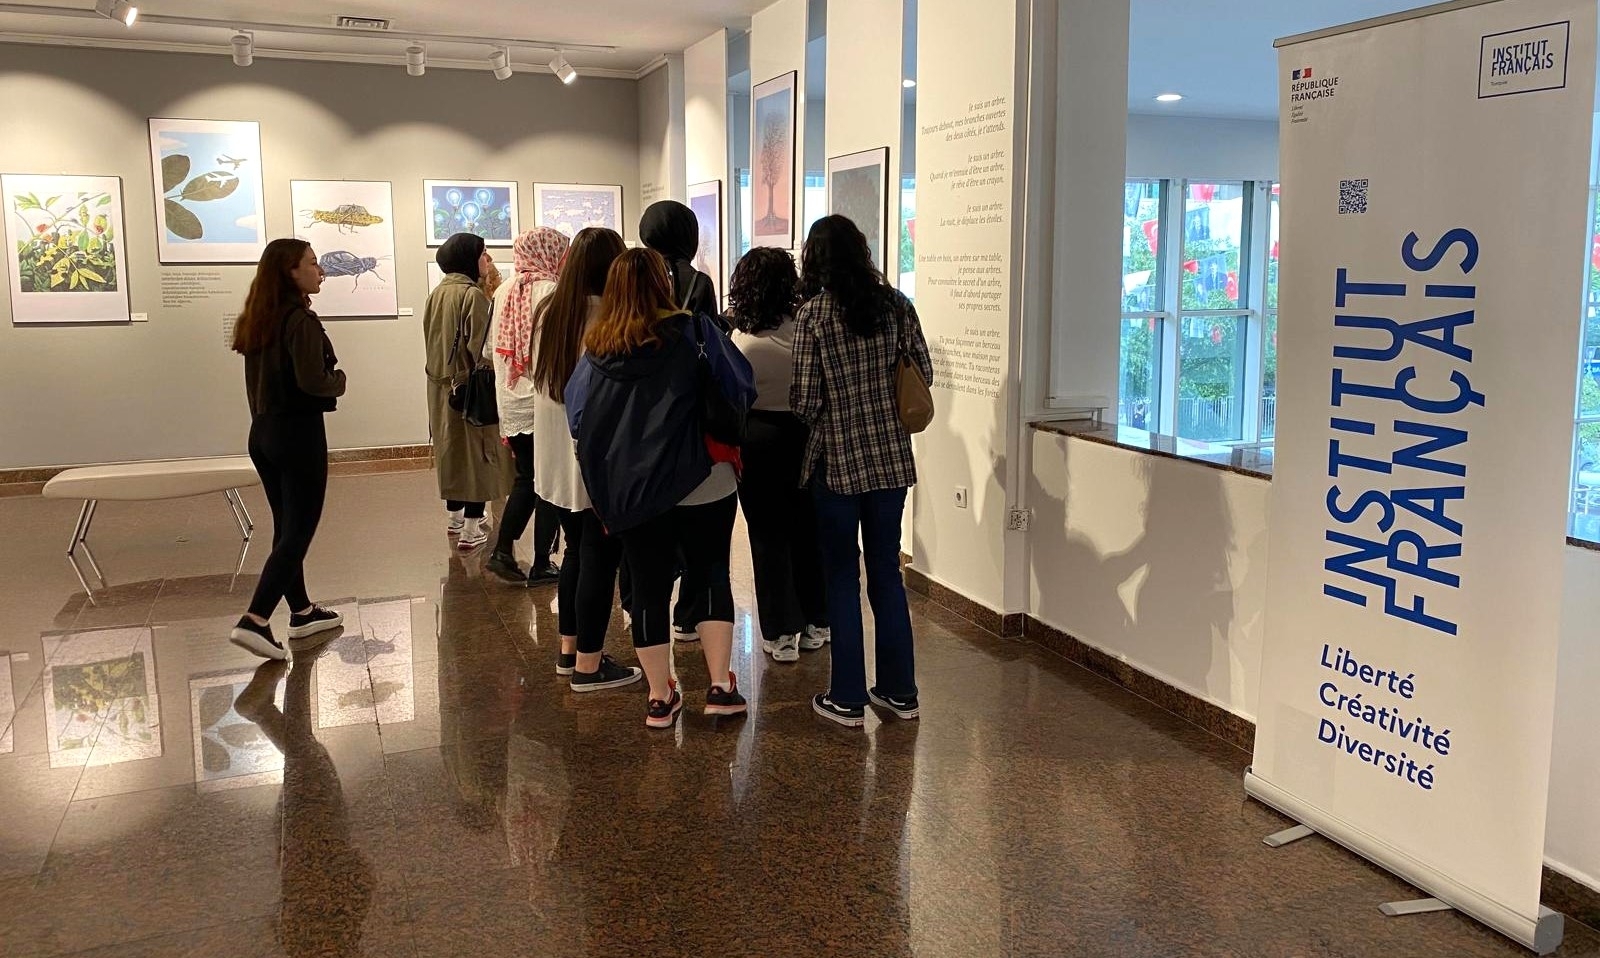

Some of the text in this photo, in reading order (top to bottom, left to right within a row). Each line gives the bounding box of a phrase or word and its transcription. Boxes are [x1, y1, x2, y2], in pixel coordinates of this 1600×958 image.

[1492, 40, 1548, 63] INSTITUT
[1291, 76, 1339, 92] RÉPUBLIQUE
[1291, 88, 1335, 102] FRANÇAISE
[974, 101, 983, 110] suis
[984, 101, 991, 109] un
[991, 96, 1006, 106] arbre.
[955, 119, 964, 127] mes
[964, 113, 985, 126] branches
[986, 110, 1006, 121] ouvertes
[973, 154, 982, 162] suis
[929, 170, 944, 182] Quand
[982, 204, 989, 212] un
[960, 253, 971, 262] arbre
[972, 254, 980, 262] sur
[963, 278, 976, 287] secret
[981, 291, 1002, 301] partager
[970, 328, 979, 336] suis
[982, 339, 1001, 350] berceau
[971, 352, 989, 361] maison
[1323, 268, 1407, 608] INSTITUT
[1320, 644, 1415, 699] Liberté
[1319, 682, 1452, 756] Créativité
[1318, 718, 1435, 790] Diversité
